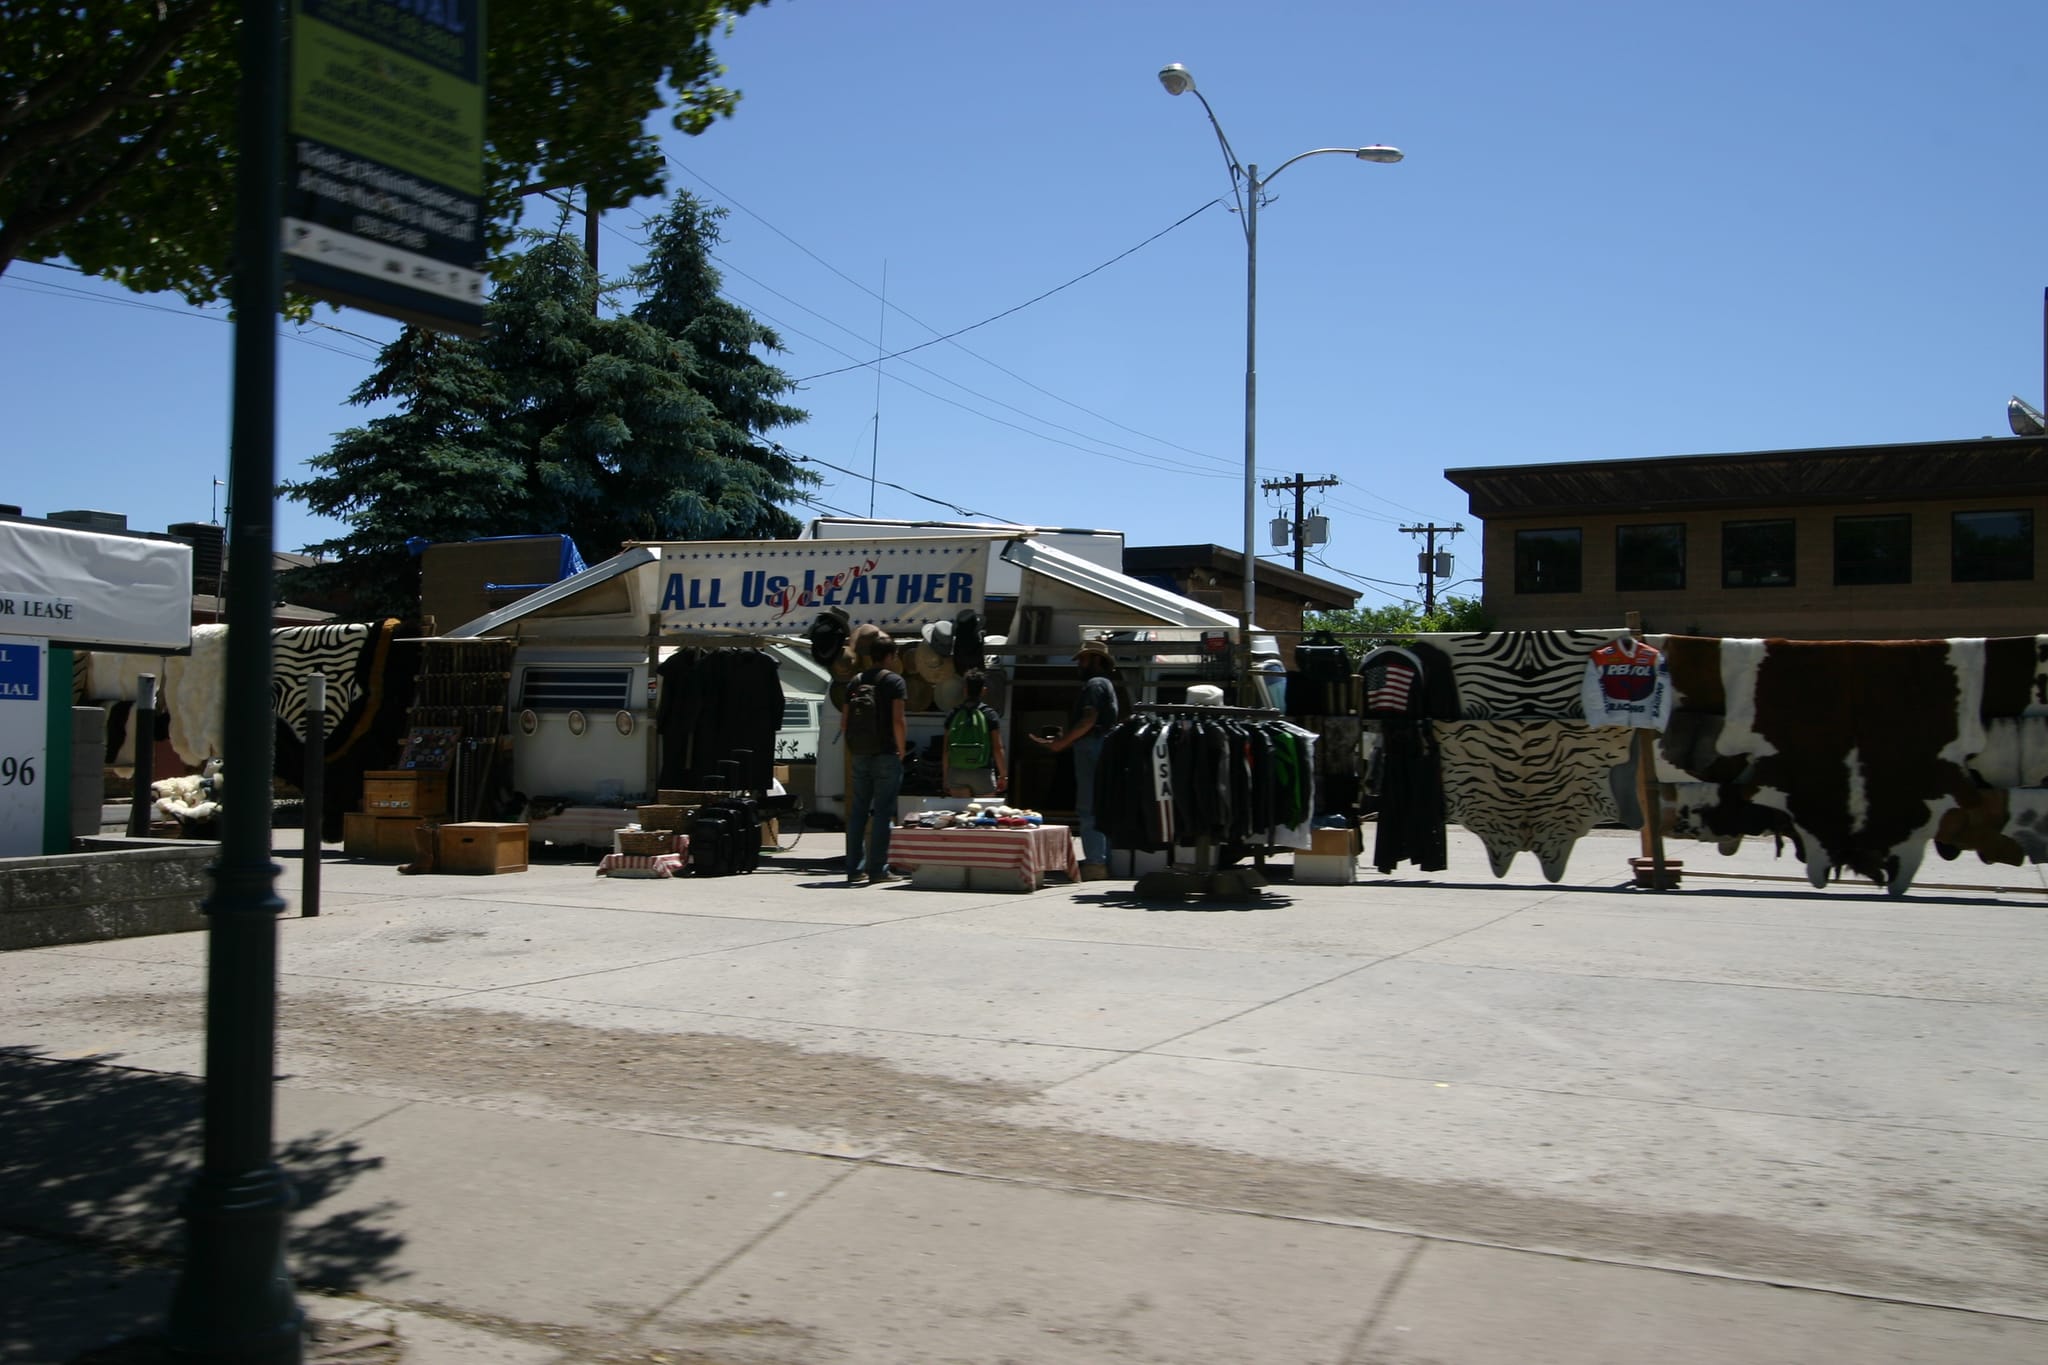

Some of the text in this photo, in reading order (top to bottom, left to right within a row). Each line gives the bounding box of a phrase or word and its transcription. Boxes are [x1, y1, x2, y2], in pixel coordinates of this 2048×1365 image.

[661, 573, 726, 610] ALL
[803, 570, 974, 607] LEATHER
[23, 600, 73, 620] LEASE
[2, 756, 35, 786] 96
[1156, 743, 1172, 797] USA
